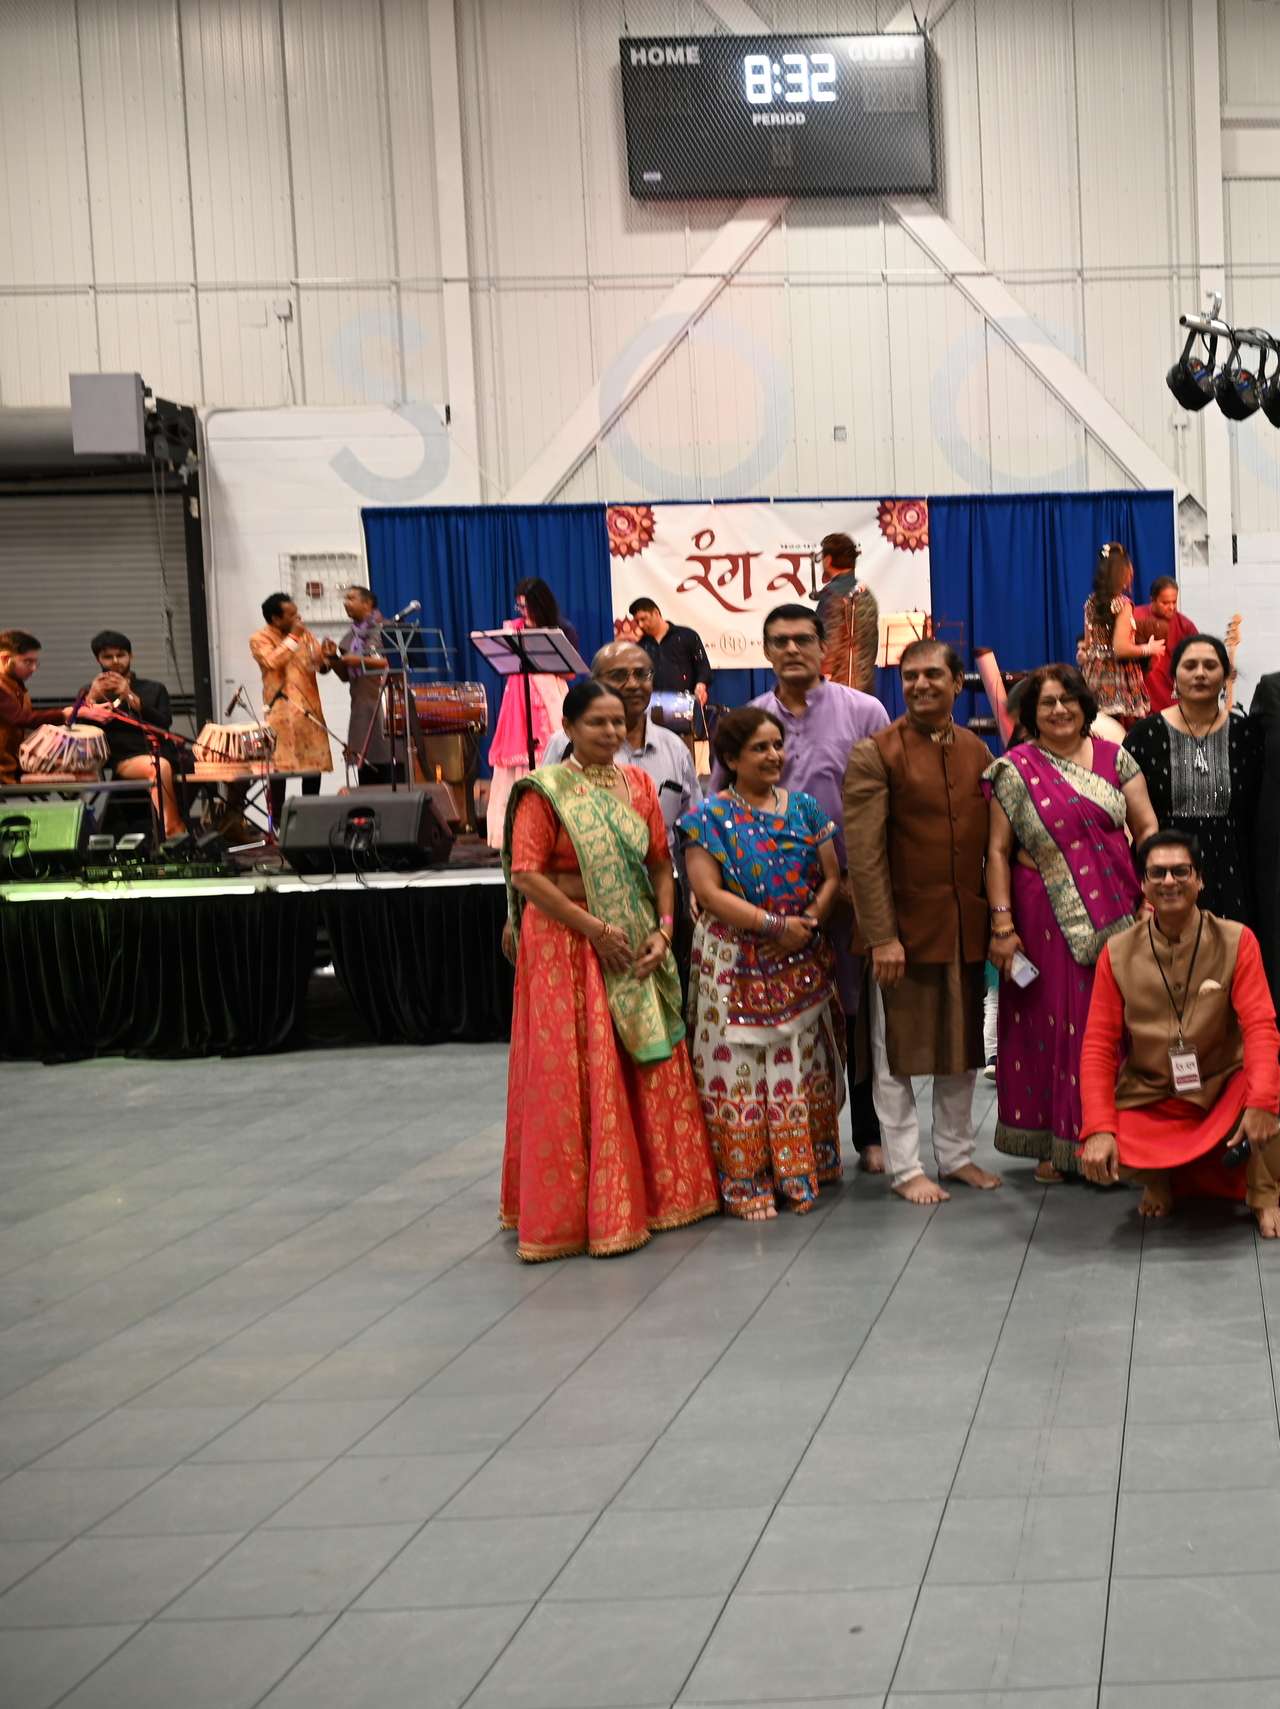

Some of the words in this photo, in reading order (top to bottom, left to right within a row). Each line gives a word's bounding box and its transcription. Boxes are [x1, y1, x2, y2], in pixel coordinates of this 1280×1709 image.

[630, 46, 700, 66] HOME
[745, 53, 836, 104] 8:32
[752, 112, 806, 126] PERIOD
[676, 528, 765, 613] रंग
